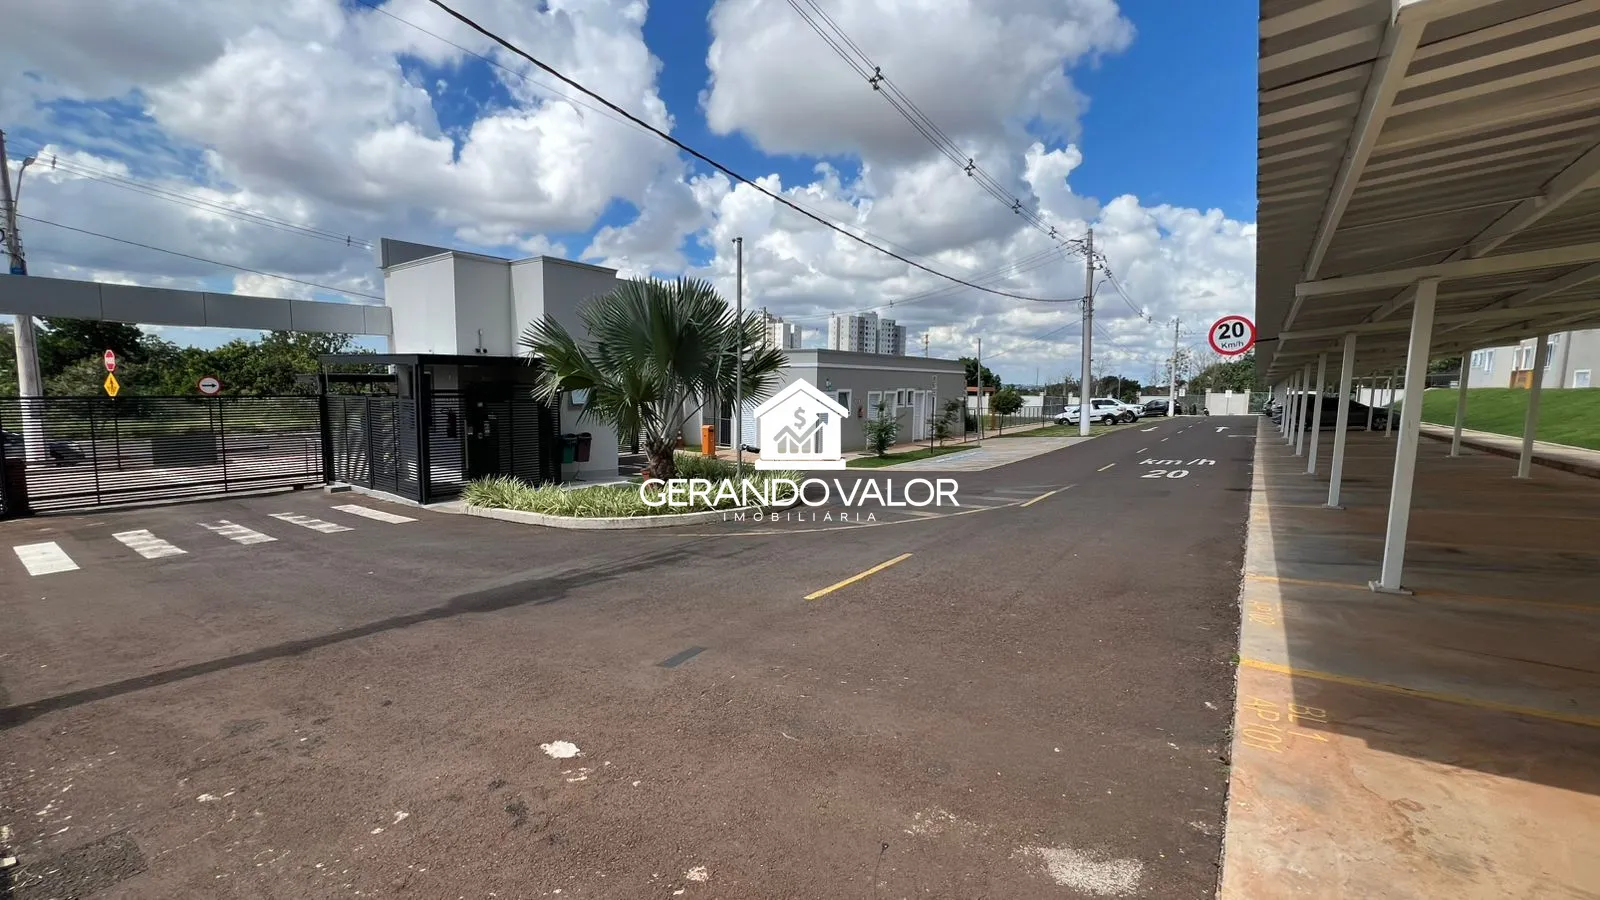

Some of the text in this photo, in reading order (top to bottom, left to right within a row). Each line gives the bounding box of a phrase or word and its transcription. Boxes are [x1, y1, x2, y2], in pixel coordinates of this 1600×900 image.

[1218, 321, 1245, 340] 20
[1220, 340, 1244, 349] Km/h
[1140, 469, 1190, 479] 20
[1287, 702, 1328, 723] BL
